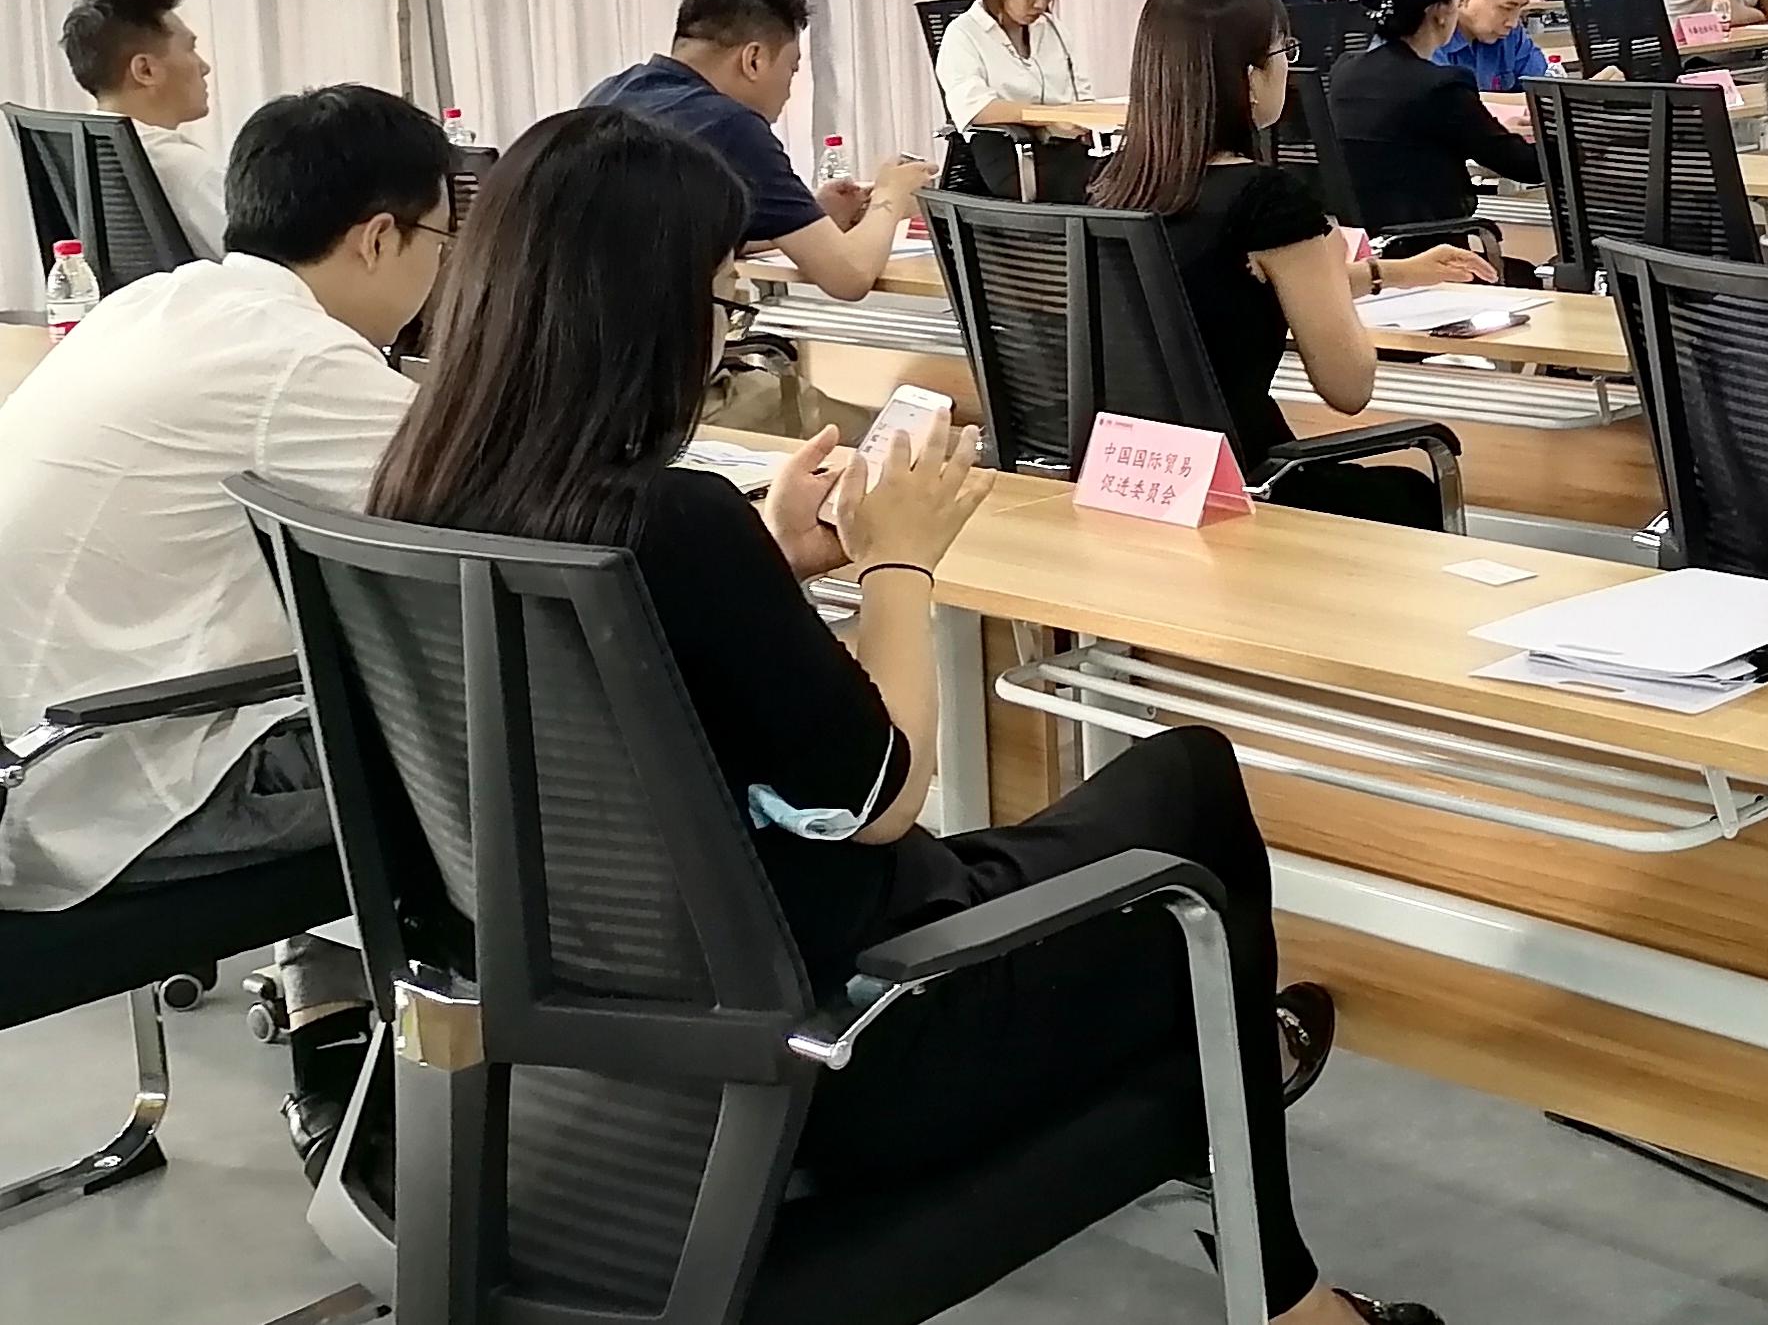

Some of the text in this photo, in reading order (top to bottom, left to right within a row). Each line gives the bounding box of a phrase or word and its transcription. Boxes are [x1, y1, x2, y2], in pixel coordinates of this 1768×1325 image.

[1104, 442, 1193, 478] 中国国际贸易
[1099, 473, 1177, 506] 促进委员会
